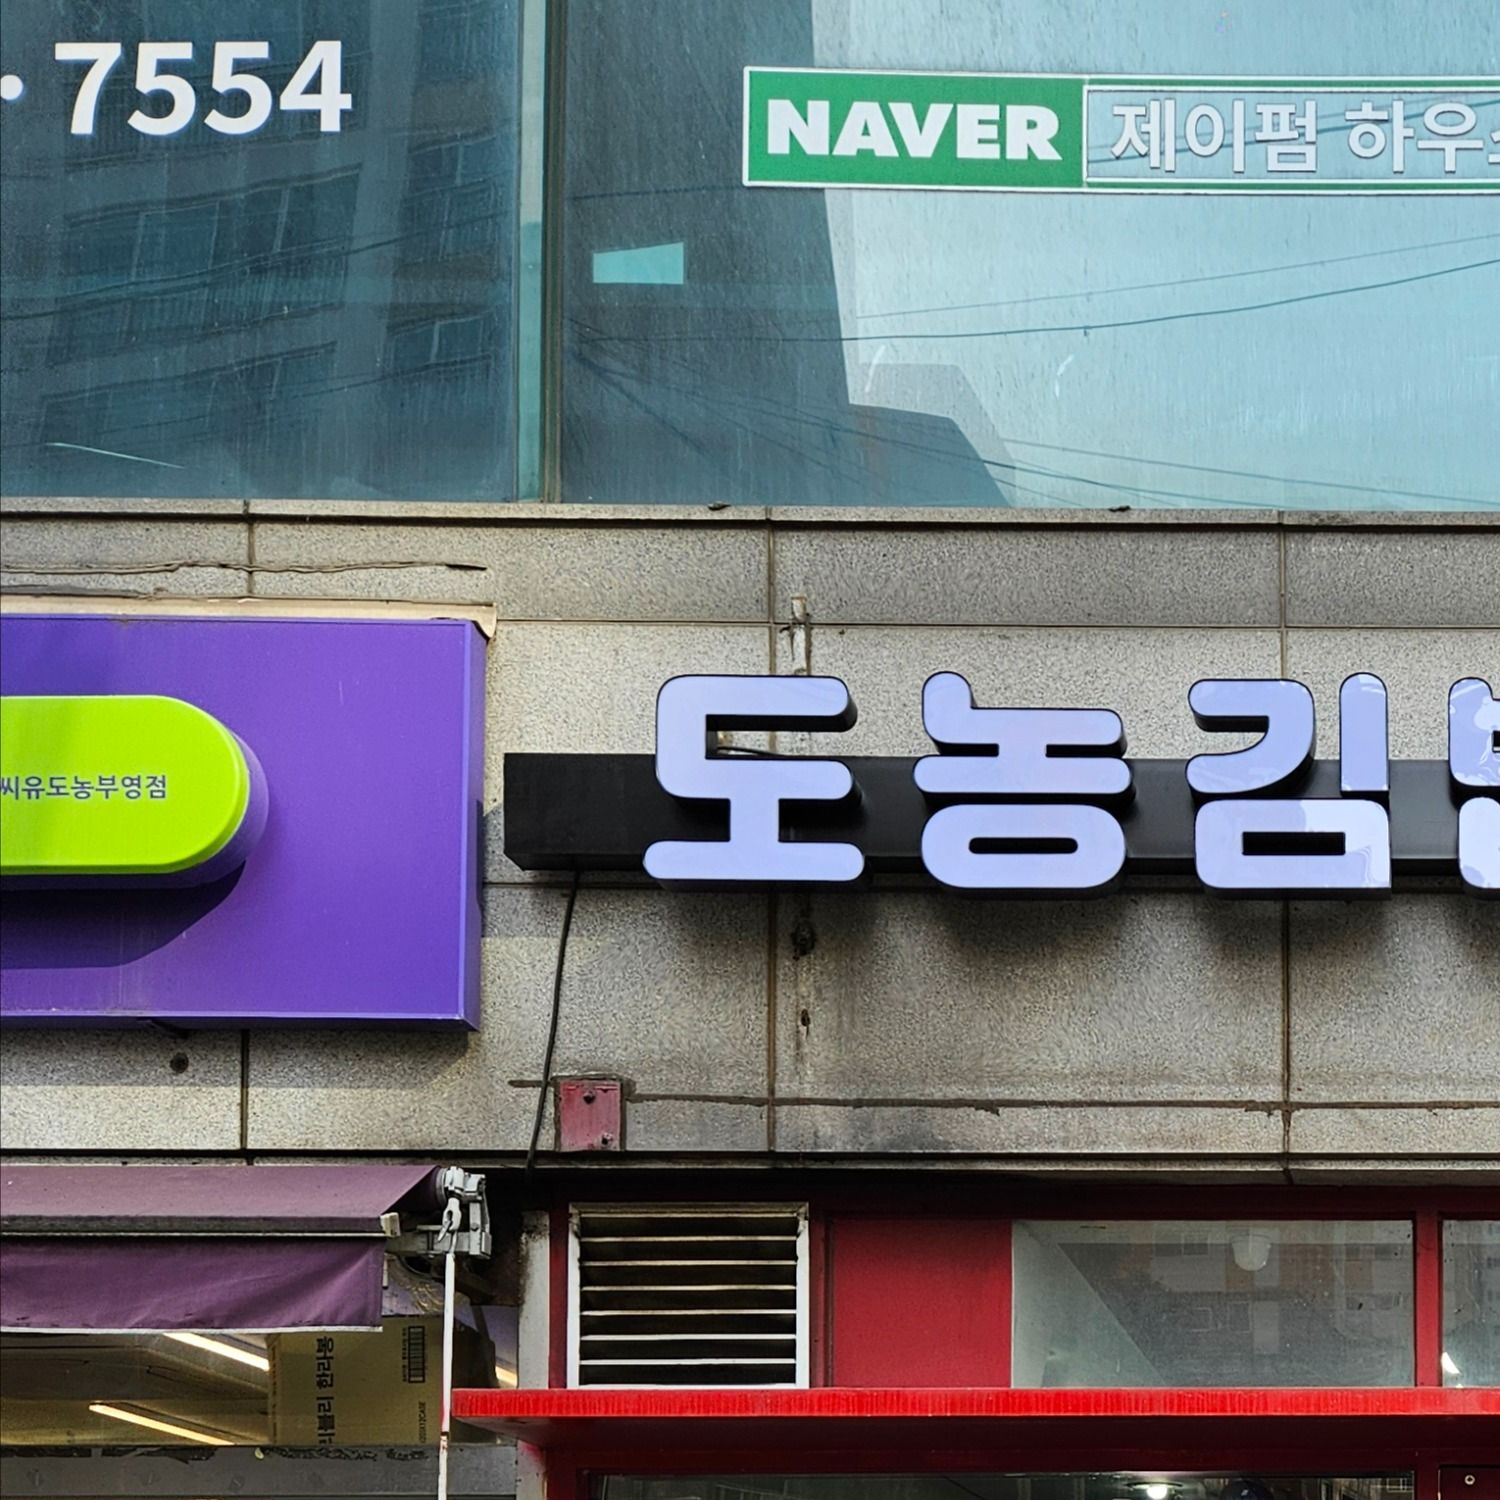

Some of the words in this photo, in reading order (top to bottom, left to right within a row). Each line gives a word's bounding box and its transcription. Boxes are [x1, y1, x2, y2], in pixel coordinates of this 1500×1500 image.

[767, 99, 1062, 160] NAVER
[1109, 99, 1319, 173] 제이펌
[0, 775, 166, 800] 씨유도농부영점
